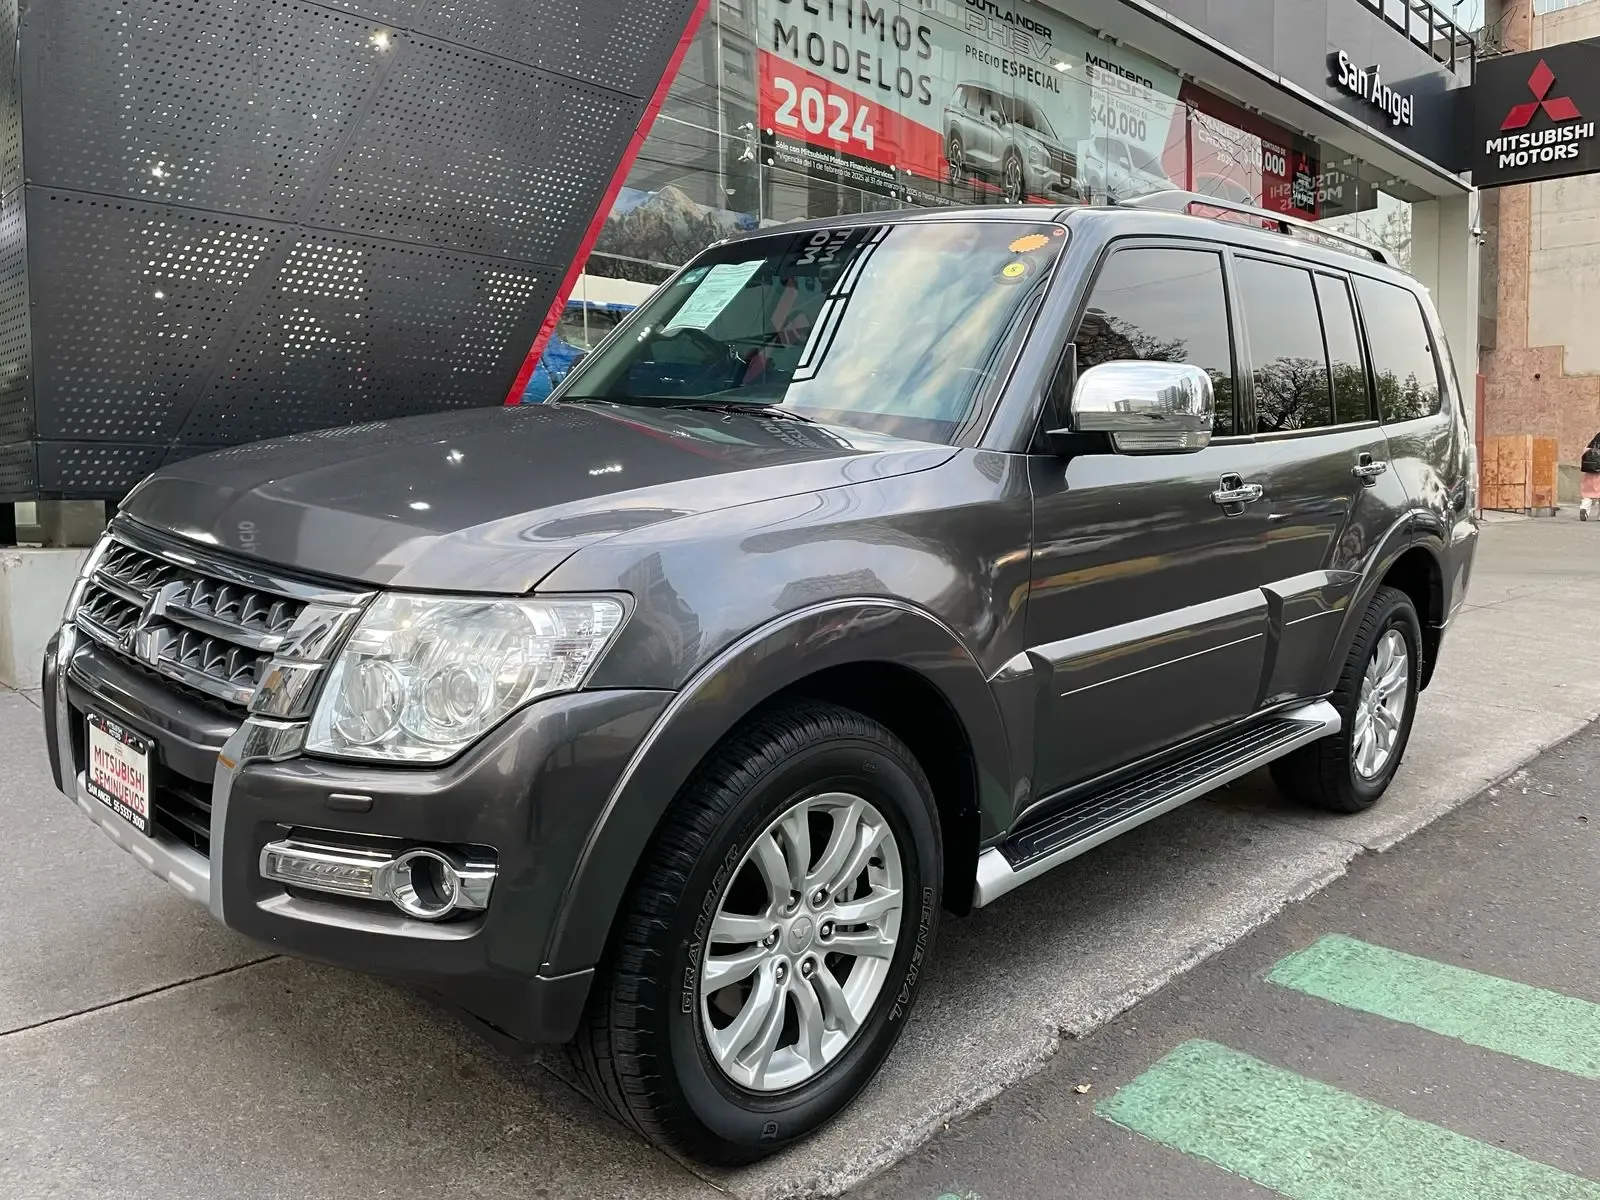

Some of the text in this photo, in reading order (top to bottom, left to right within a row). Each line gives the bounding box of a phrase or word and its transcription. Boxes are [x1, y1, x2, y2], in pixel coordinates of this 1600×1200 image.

[778, 0, 932, 60] TIMOS
[965, 7, 1053, 60] PHEV
[774, 18, 932, 106] MODELOS
[965, 44, 1060, 94] PRECIO ESPECIAL
[1085, 51, 1153, 90] Montero
[1338, 49, 1414, 127] San Ángel
[774, 77, 874, 151] 2024
[1090, 104, 1146, 141] $40,000
[1486, 122, 1595, 154] MITSUBISHI
[775, 140, 789, 151] Sólo
[789, 145, 800, 154] con
[800, 147, 829, 162] Mitsubishi
[829, 155, 849, 168] Motors
[849, 161, 873, 174] Financial
[1499, 143, 1578, 169] MOTORS
[87, 782, 98, 797] SAN
[94, 744, 145, 793] MITSUBISHI
[94, 767, 145, 814] SEMINUEVOS
[889, 886, 934, 1021] GENERAL
